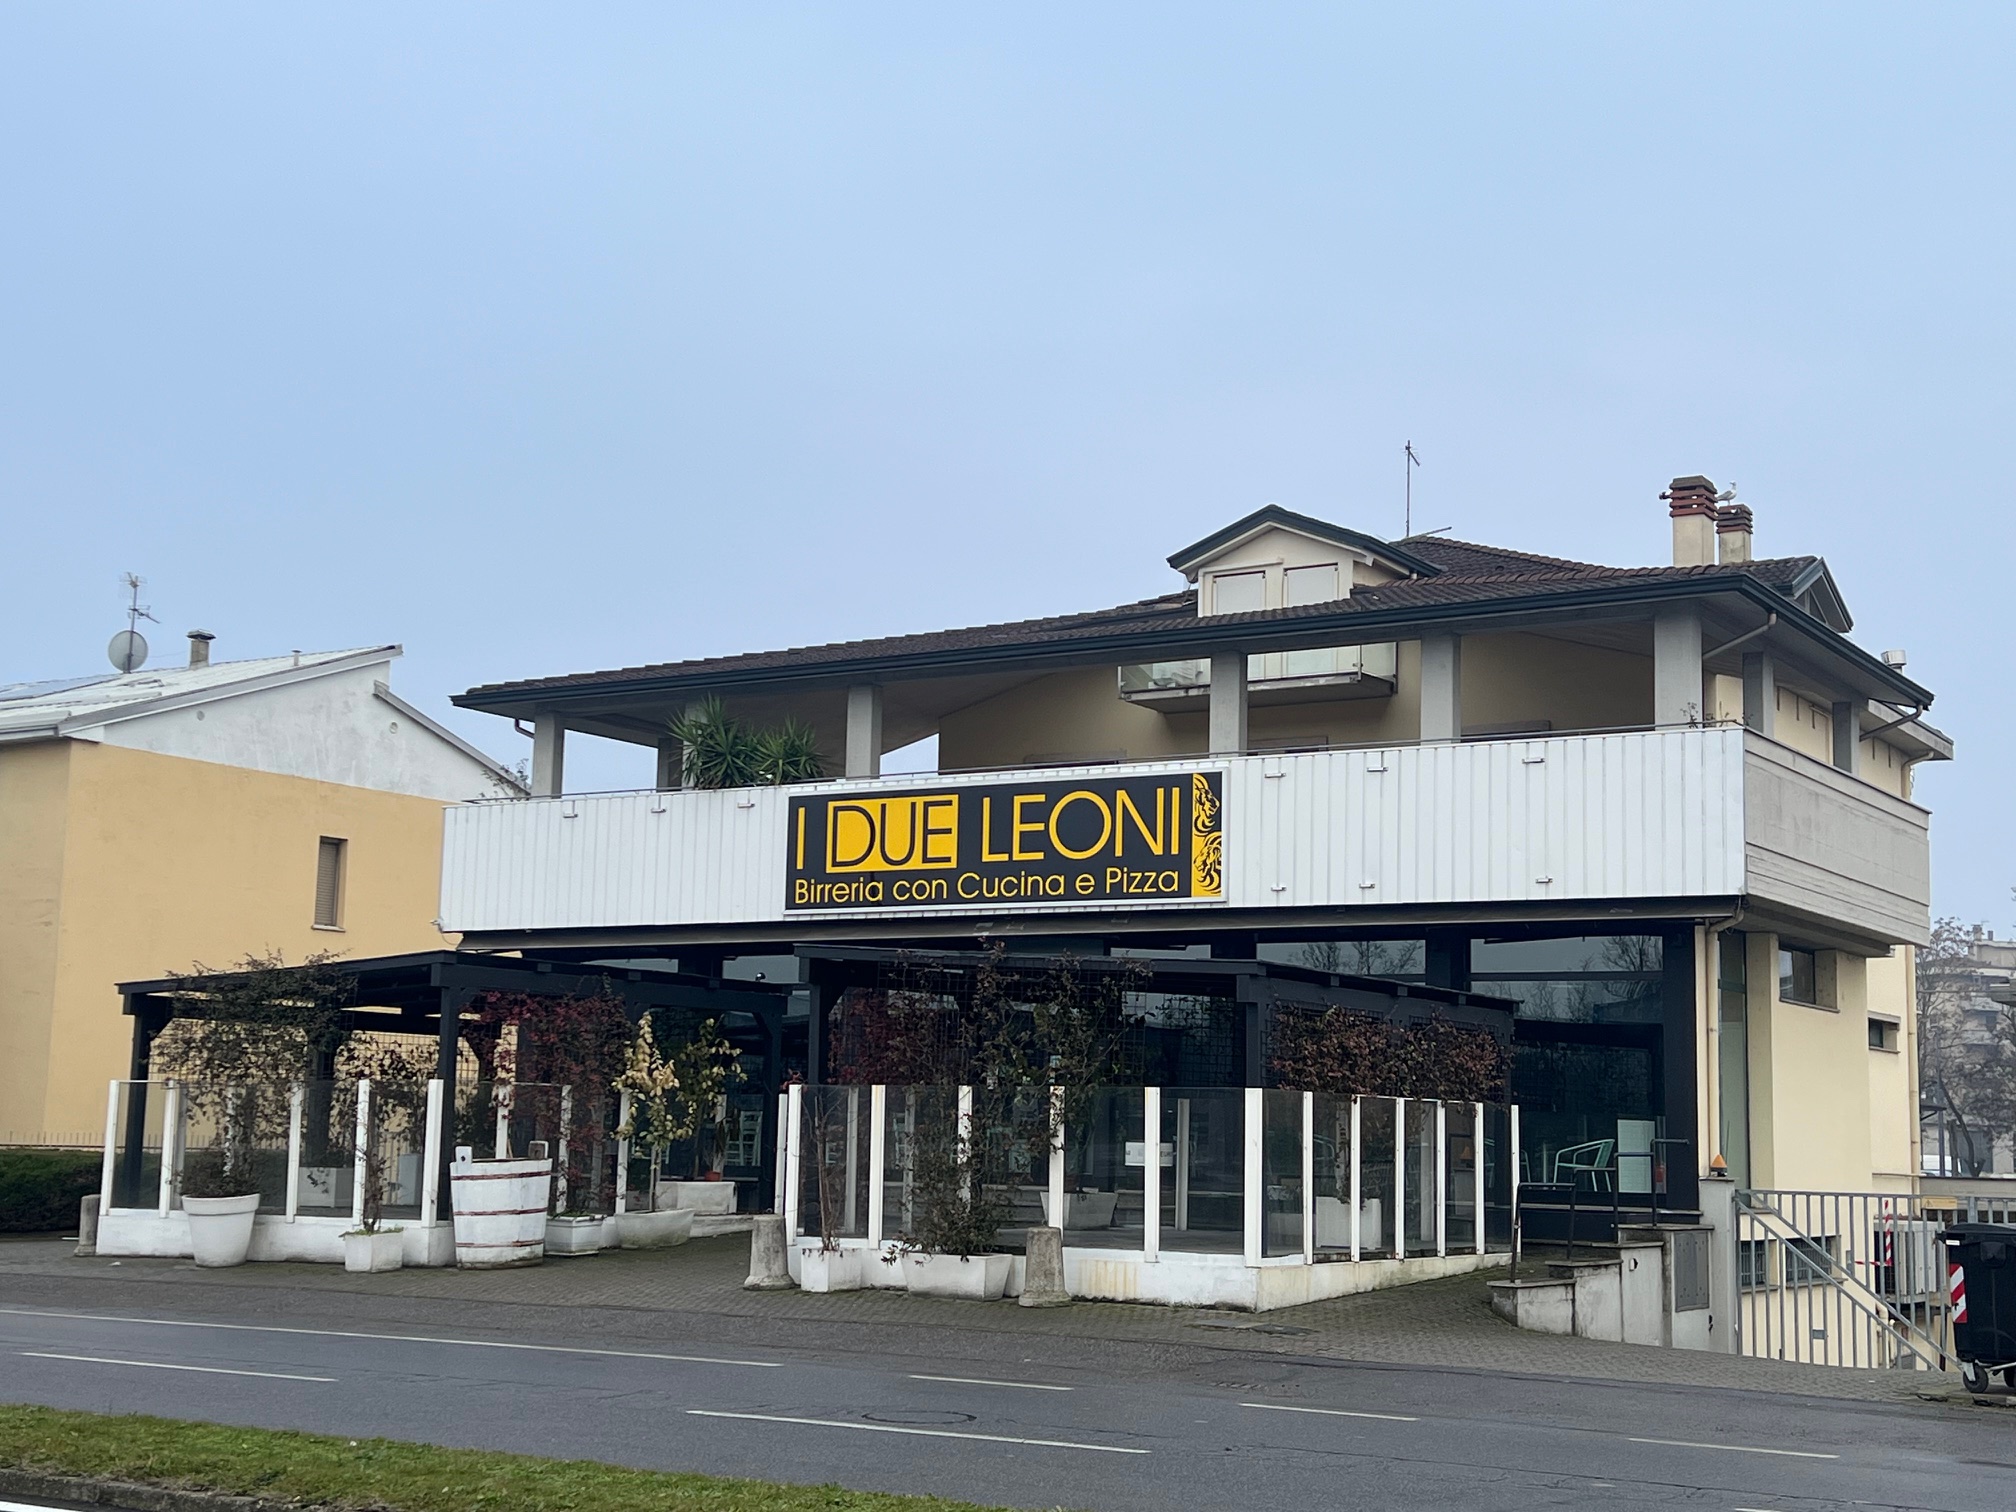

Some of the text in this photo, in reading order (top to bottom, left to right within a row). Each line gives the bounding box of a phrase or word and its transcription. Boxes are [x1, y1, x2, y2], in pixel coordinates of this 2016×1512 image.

[796, 786, 1180, 870] I DUE LEONI
[794, 867, 1179, 903] Birreria con Cucina e Pizza
